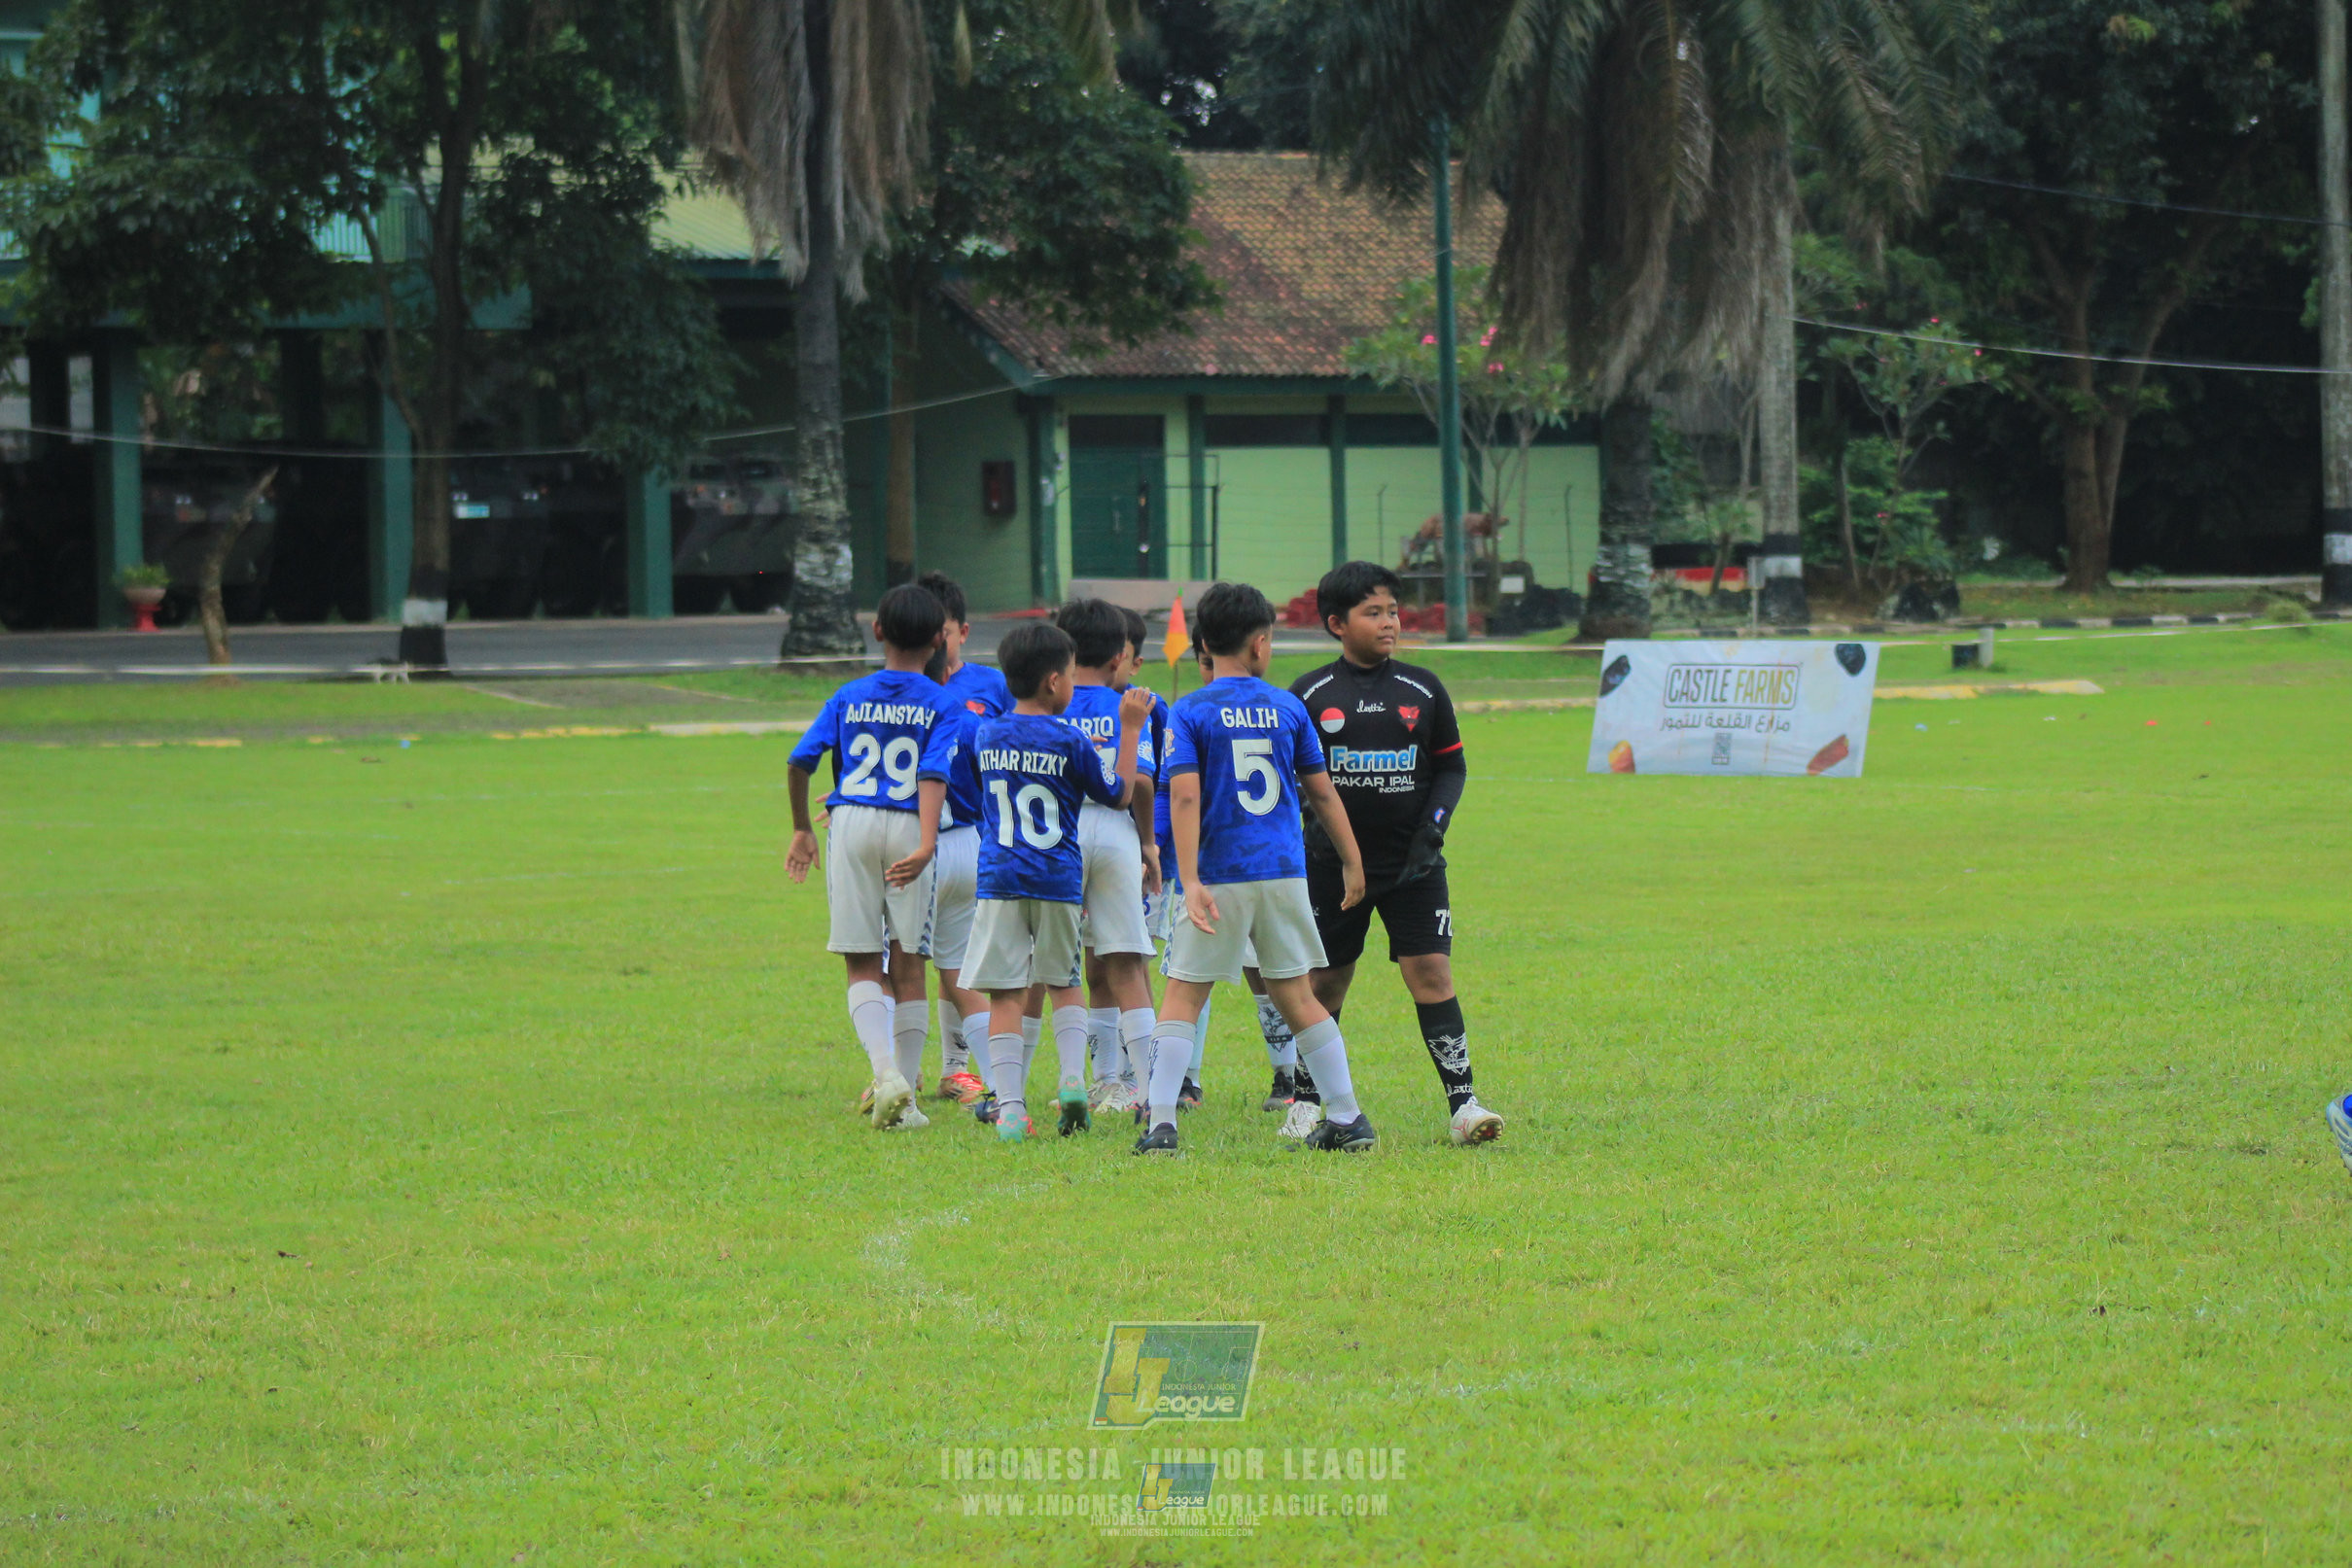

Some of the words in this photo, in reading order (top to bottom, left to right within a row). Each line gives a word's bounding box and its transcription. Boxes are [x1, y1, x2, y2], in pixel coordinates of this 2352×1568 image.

[1667, 668, 1732, 703] CASTLE
[1734, 669, 1795, 705] FARMS
[845, 701, 936, 730] AJIANSYAH
[1220, 707, 1280, 729] GALIH
[1659, 713, 1703, 732] للتمور
[1704, 712, 1752, 730] القلعة
[1755, 714, 1791, 733] مزارع
[840, 732, 920, 801] 29
[980, 749, 1021, 773] ATHAR
[1022, 750, 1069, 777] RIZKY
[1329, 745, 1419, 772] Farmel
[1231, 739, 1281, 816] 5
[1331, 776, 1386, 787] PAKAR
[1389, 775, 1416, 786] IPAL
[989, 779, 1064, 851] 10
